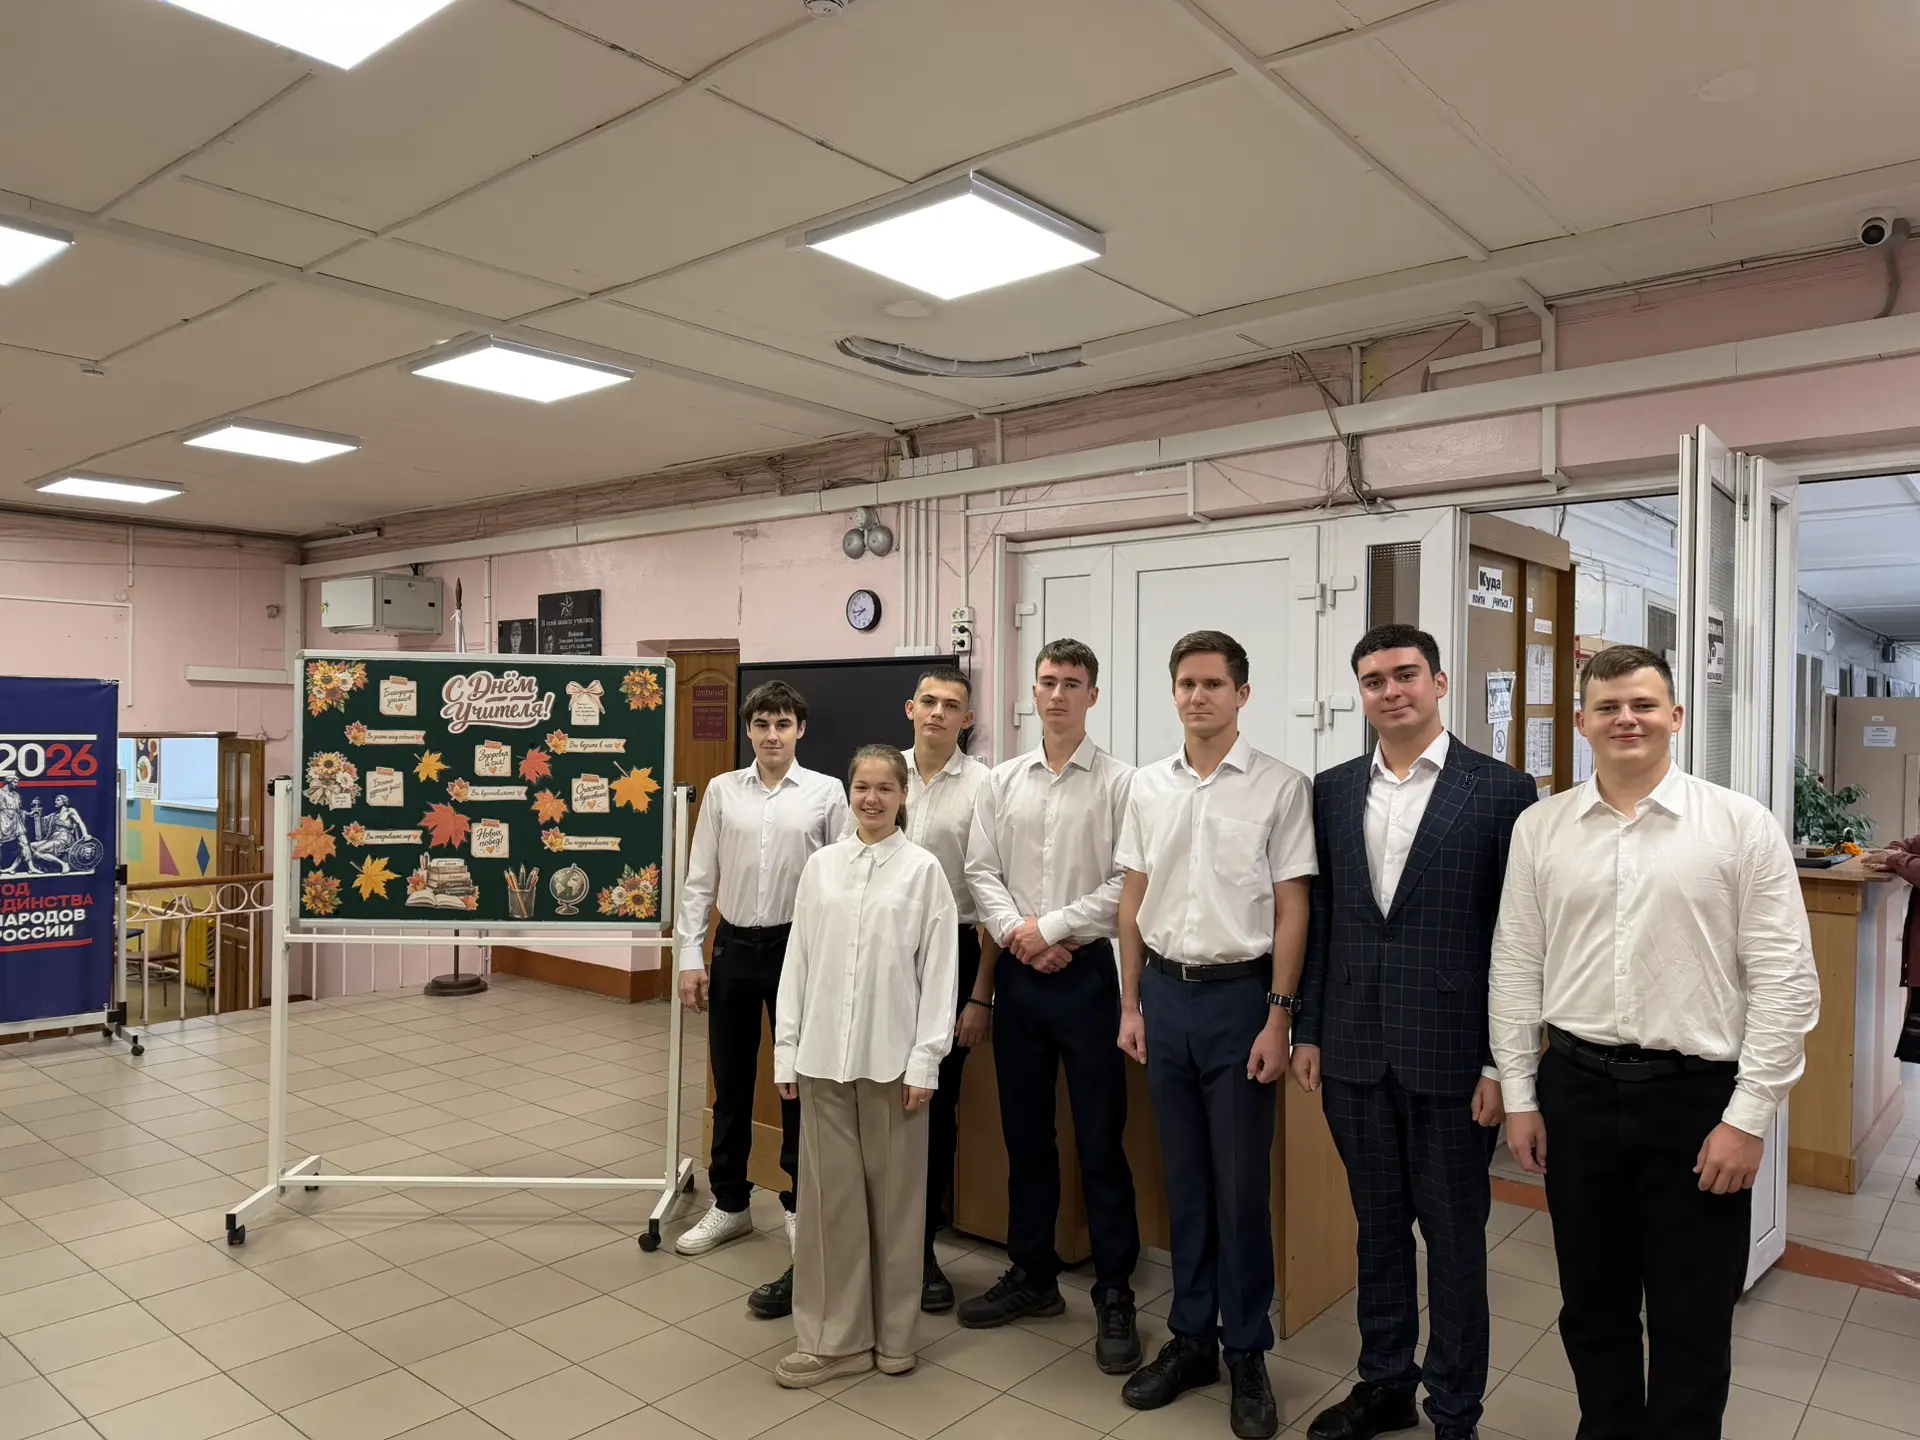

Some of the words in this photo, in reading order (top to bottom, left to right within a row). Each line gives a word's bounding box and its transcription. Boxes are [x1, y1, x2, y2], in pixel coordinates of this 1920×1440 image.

[1479, 570, 1502, 592] Куда
[1472, 592, 1486, 605] пойти
[444, 677, 464, 703] С
[467, 672, 537, 702] Днём
[695, 688, 725, 697] ПРИЁМНАЯ
[442, 694, 553, 733] Учителя!
[568, 740, 579, 749] Вы
[0, 742, 98, 778] 2026
[0, 882, 31, 897] ОД
[0, 893, 95, 913] ДИНСТВА
[0, 924, 75, 943] ОССИИ
